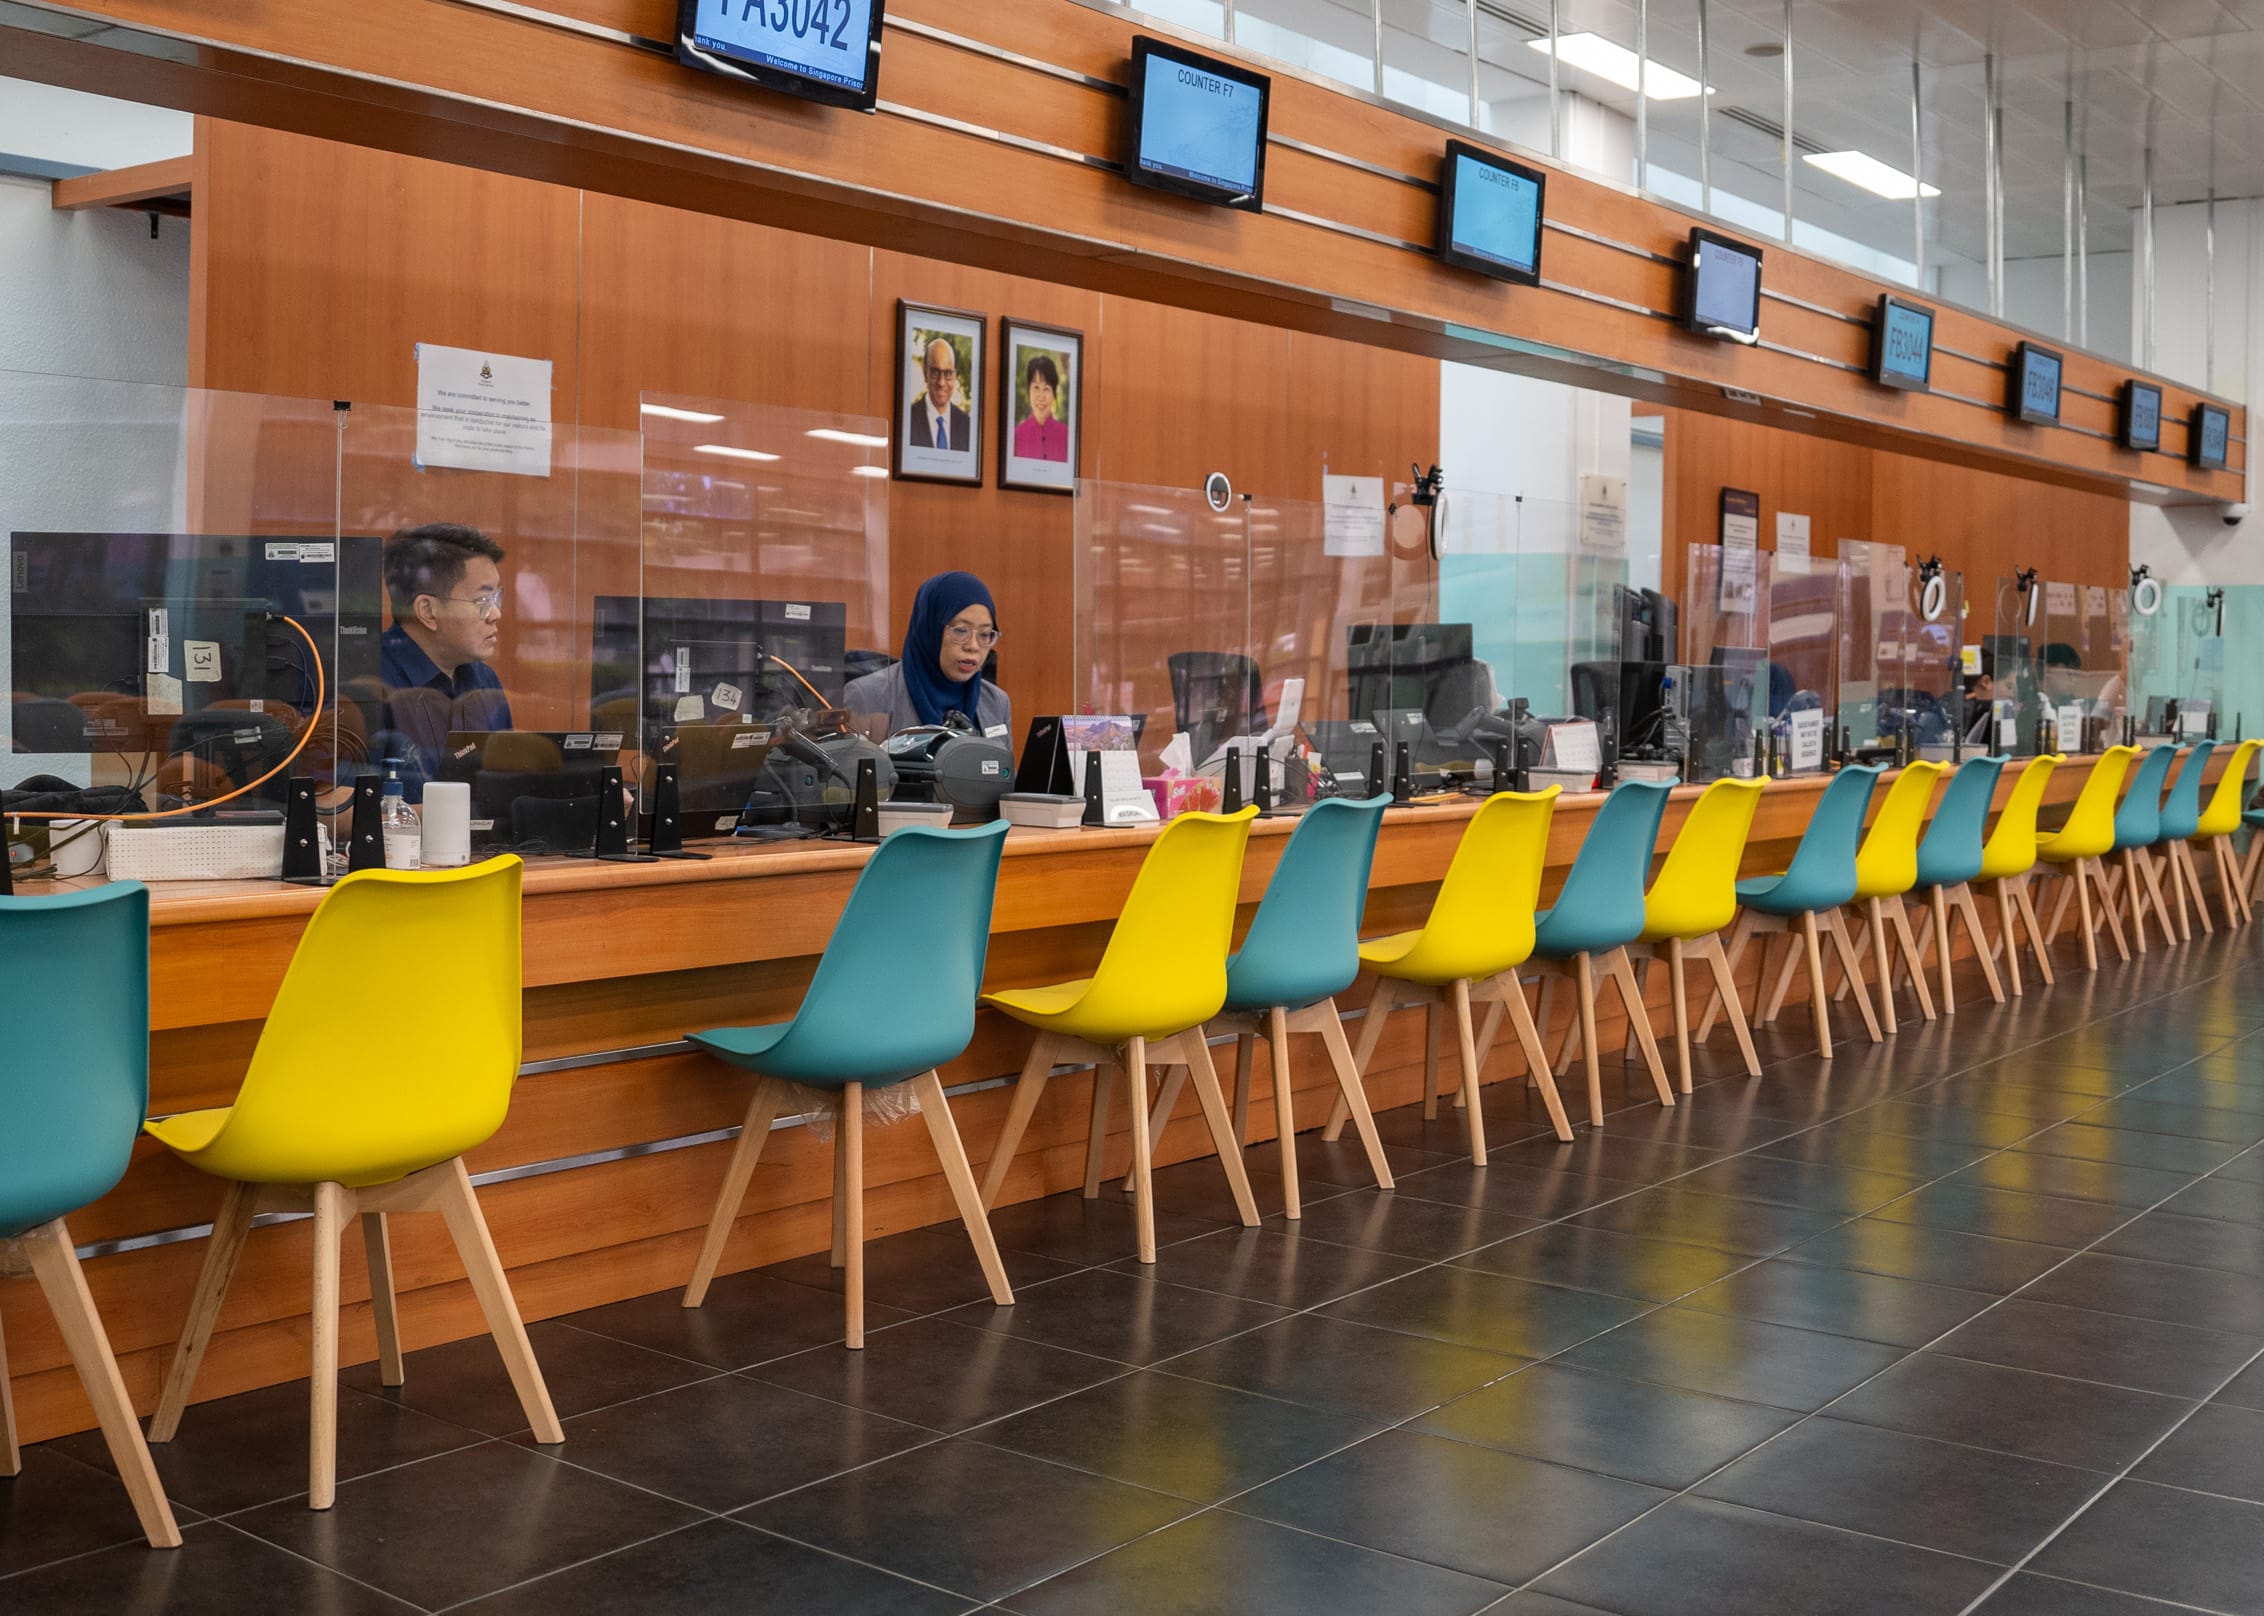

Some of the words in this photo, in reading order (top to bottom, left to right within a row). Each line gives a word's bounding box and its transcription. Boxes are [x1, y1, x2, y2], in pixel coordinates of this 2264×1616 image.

[694, 35, 710, 46] ank
[766, 54, 798, 71] Welcome
[799, 65, 807, 73] to
[808, 67, 842, 83] Singapore
[1177, 68, 1221, 95] COUNTER
[1223, 83, 1235, 98] F7
[1479, 167, 1510, 189] COUNTER
[1889, 326, 1924, 365] FB3044
[16, 555, 24, 589] Lenovo
[339, 626, 368, 635] ThinkVision
[191, 646, 212, 671] 131
[716, 687, 737, 705] 134
[453, 741, 477, 760] ThinkPad
